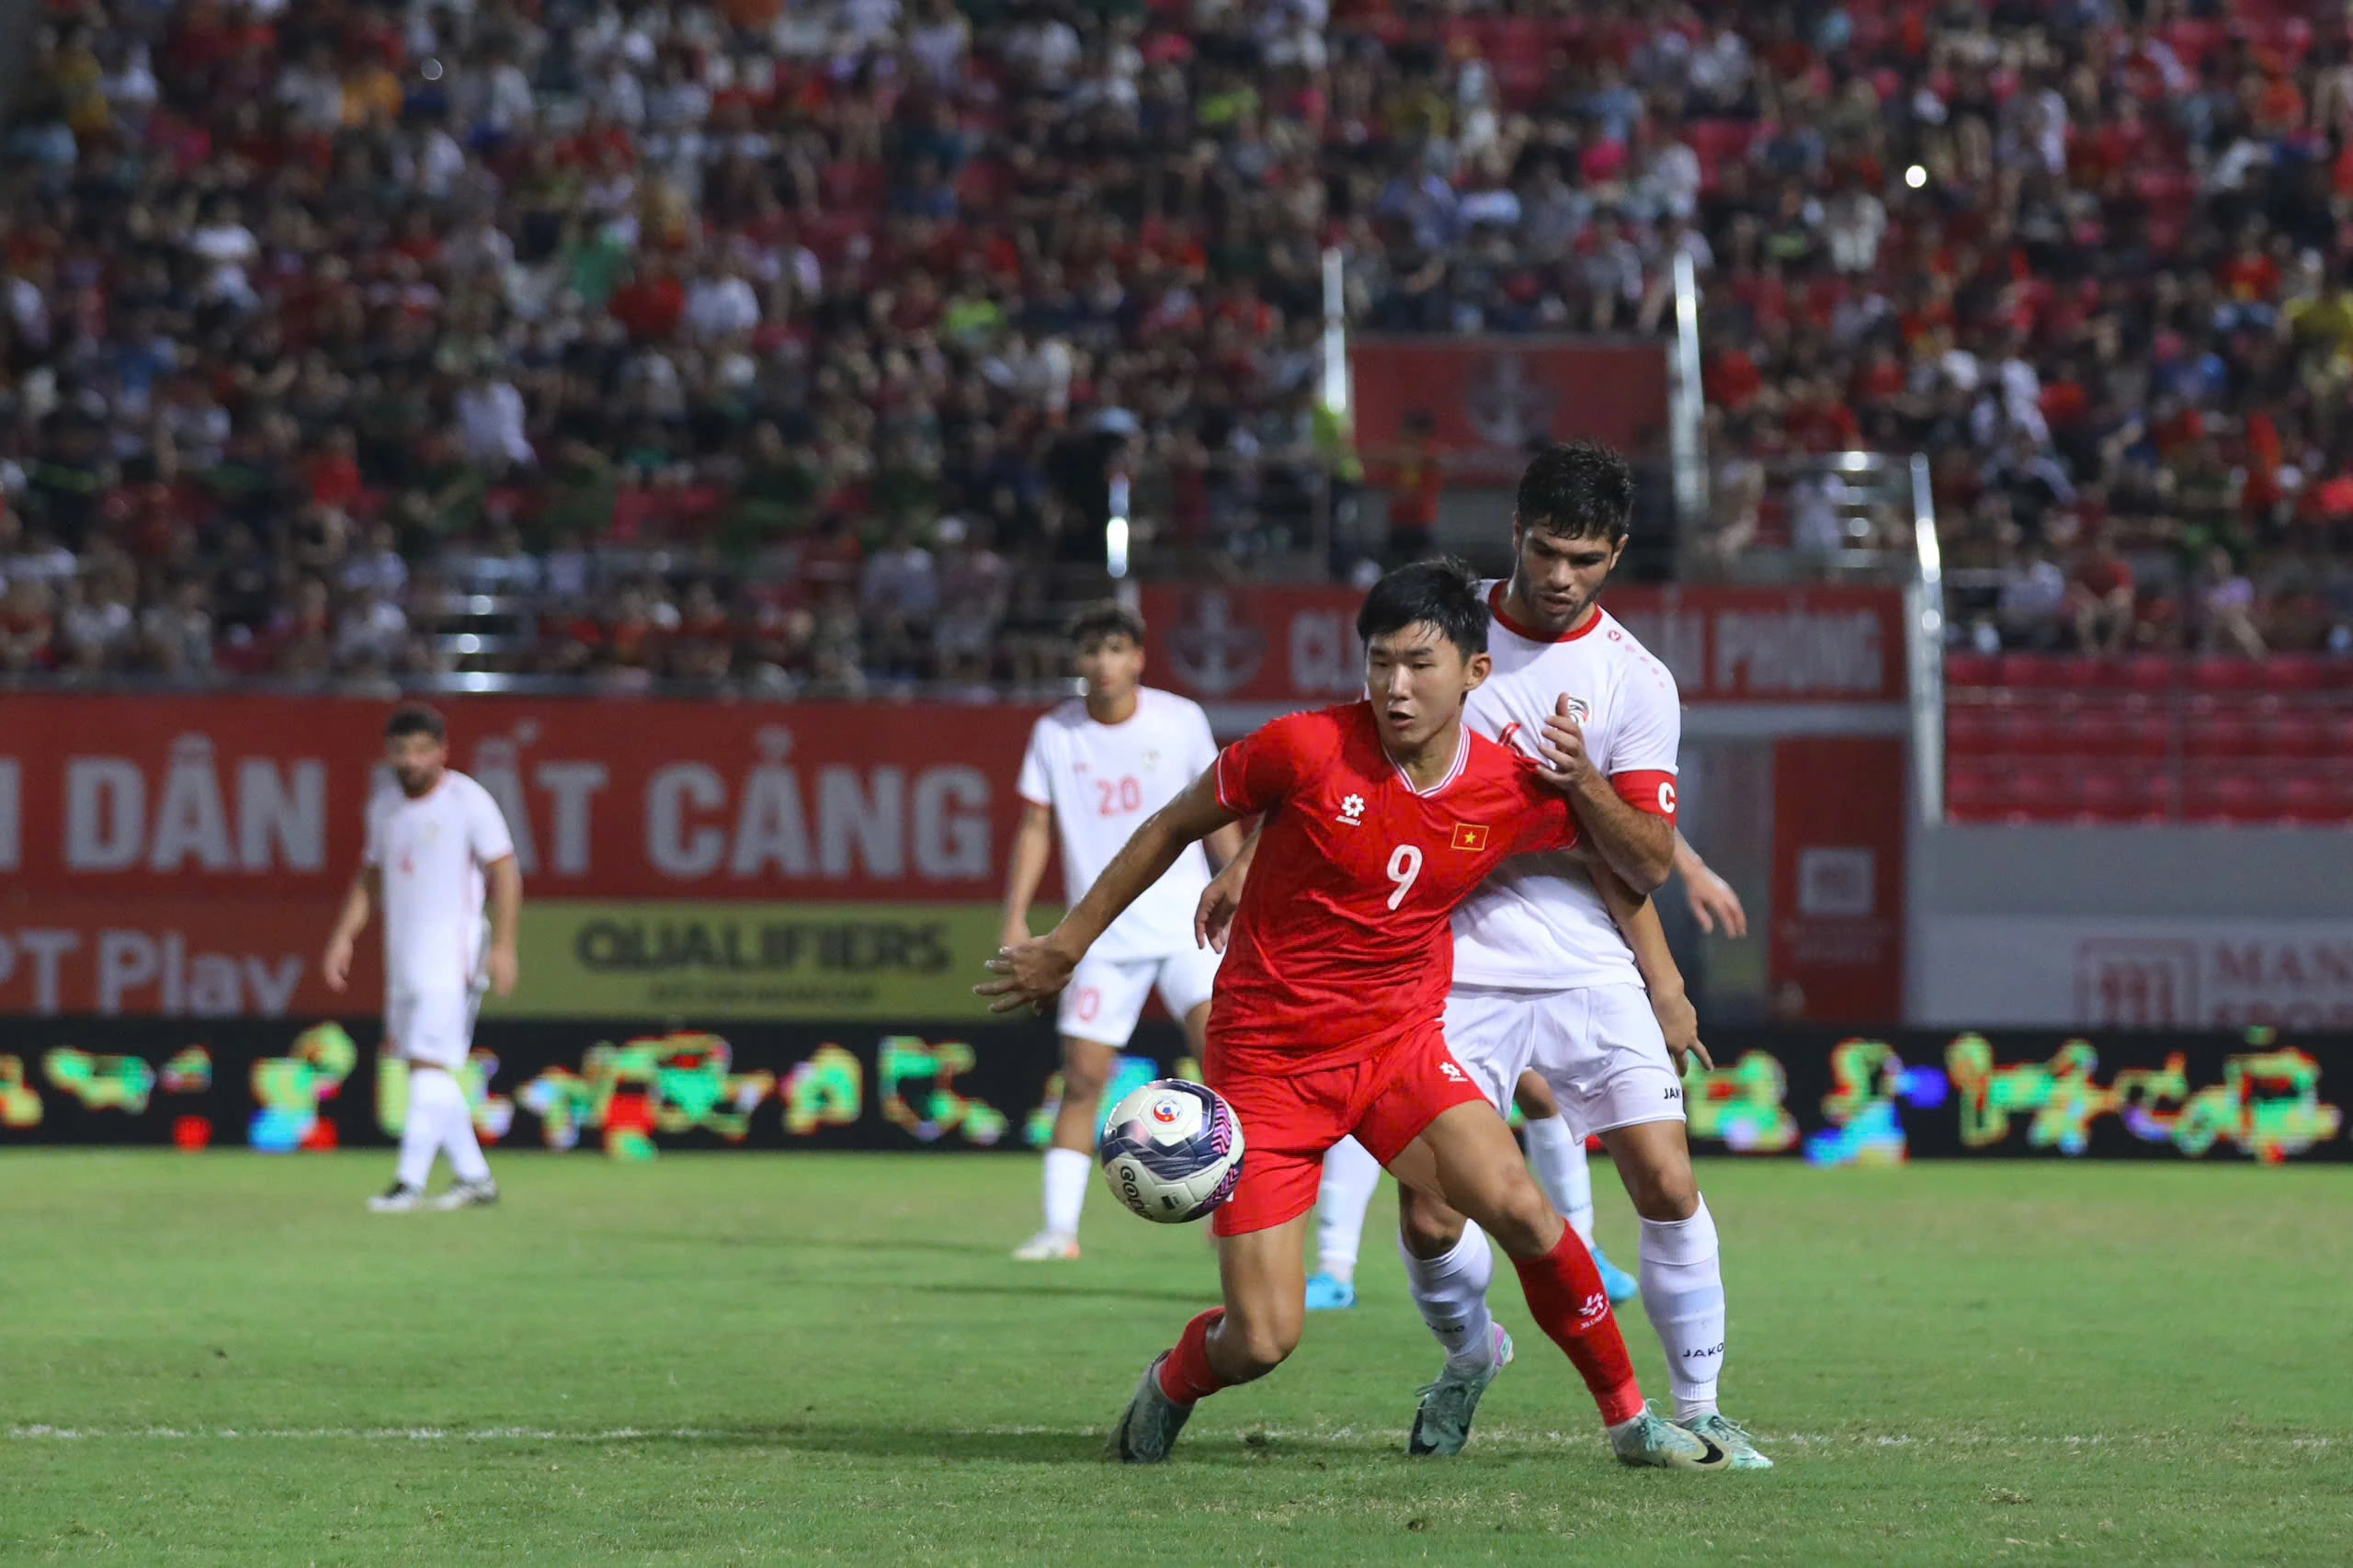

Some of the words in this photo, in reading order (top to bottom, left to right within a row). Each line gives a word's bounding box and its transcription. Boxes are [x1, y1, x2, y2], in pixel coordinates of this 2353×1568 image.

[68, 733, 325, 870] DÂN
[646, 724, 990, 879] CẢNG
[1097, 776, 1142, 816] 20
[1658, 782, 1676, 814] C
[1386, 844, 1423, 911] 9
[577, 920, 953, 975] QUALIFIERS
[1682, 1342, 1724, 1358] JAKO
